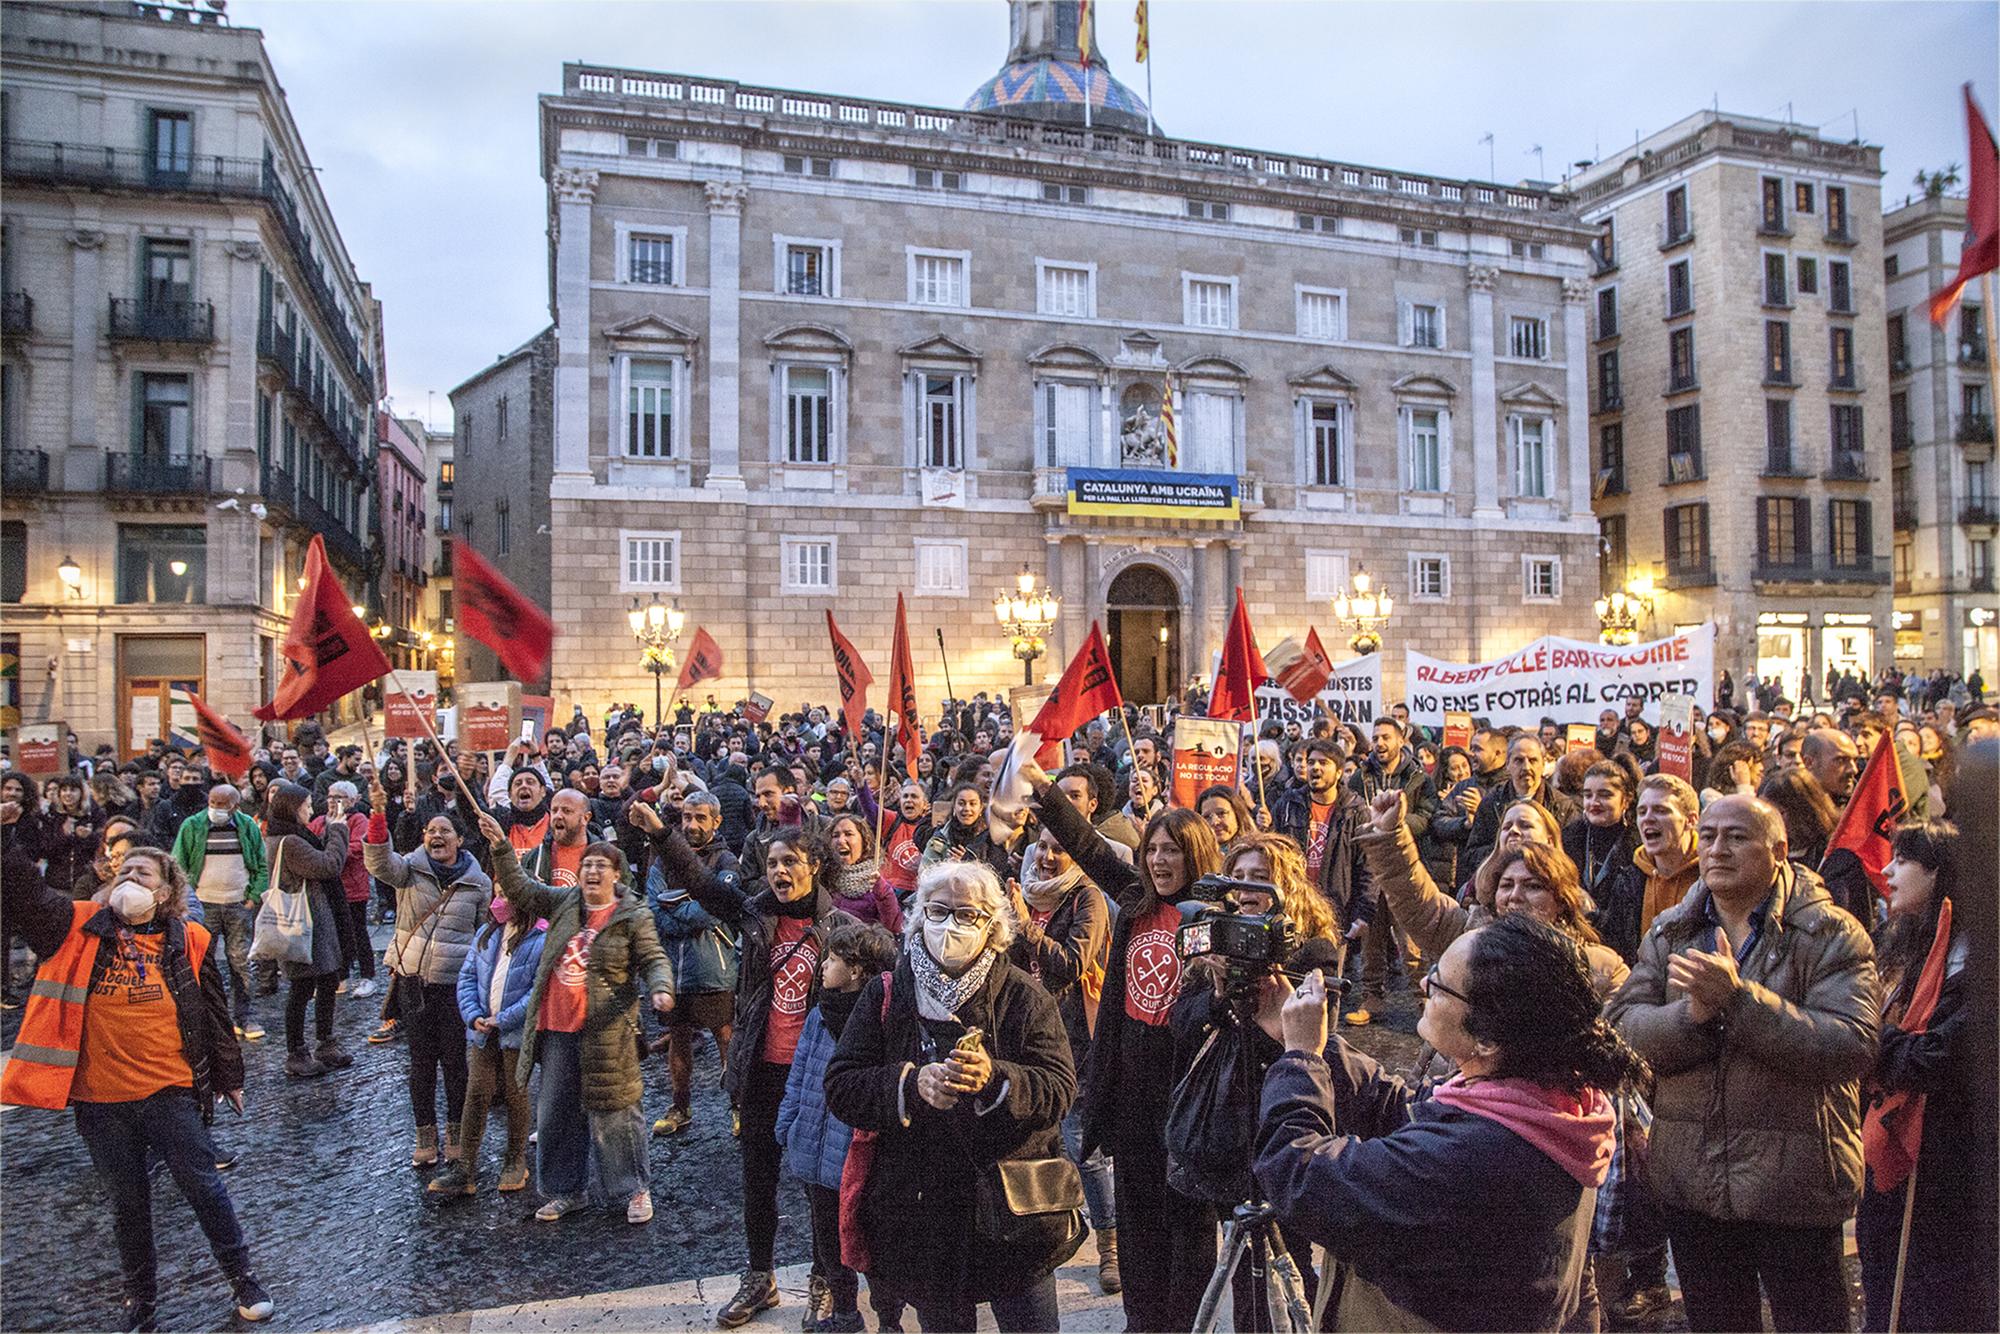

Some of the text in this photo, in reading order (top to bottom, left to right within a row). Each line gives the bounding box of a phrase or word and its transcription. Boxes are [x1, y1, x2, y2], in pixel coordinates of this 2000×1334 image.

[1083, 482, 1224, 498] CATALUNYA AMB UCRAÏNA
[1417, 664, 1494, 685] ALBERT
[1495, 646, 1548, 676] OLLÉ
[1413, 694, 1438, 713] NO
[1442, 693, 1480, 713] ENS
[1486, 681, 1562, 711] FOTRÀS
[1566, 683, 1596, 704] AL
[1188, 763, 1232, 773] REGULACIÓ
[1205, 773, 1229, 782] TOCA!
[95, 983, 117, 996] UST
